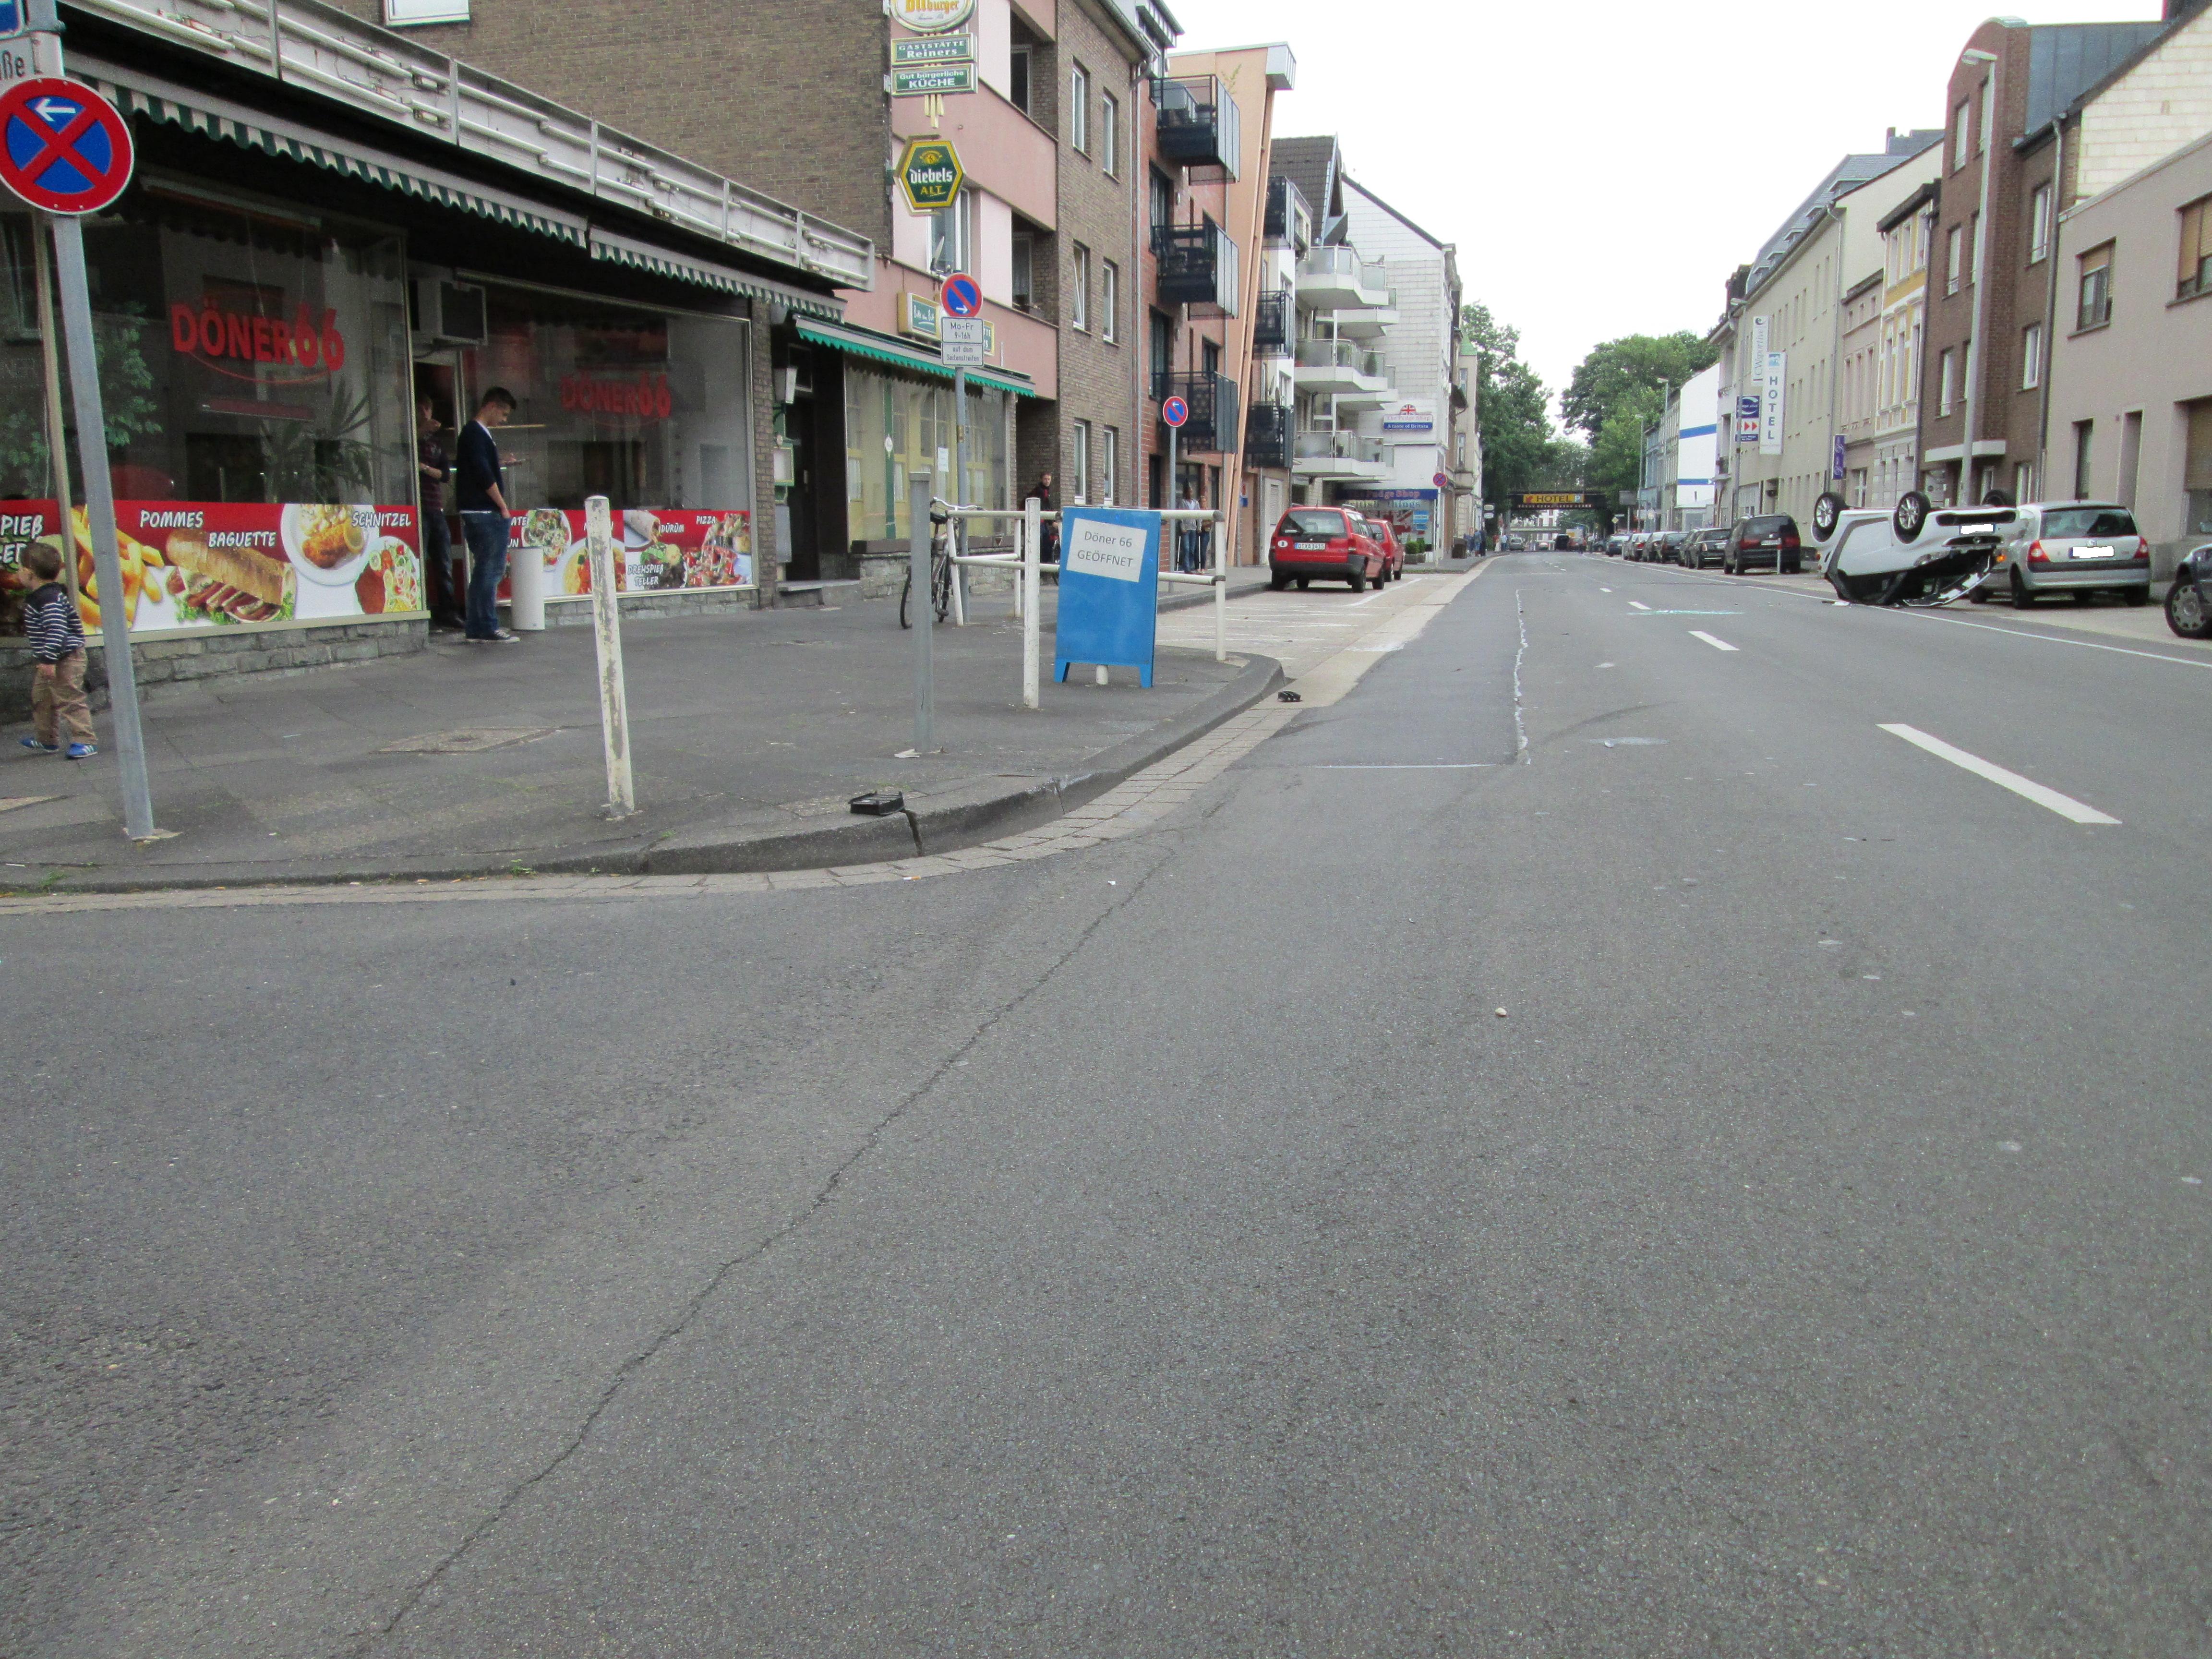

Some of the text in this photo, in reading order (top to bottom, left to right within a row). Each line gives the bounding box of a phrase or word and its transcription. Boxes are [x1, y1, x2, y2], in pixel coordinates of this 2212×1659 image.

[899, 40, 964, 51] GASTSTÄTTE
[907, 49, 957, 58] Reiners
[0, 50, 24, 79] ße
[917, 70, 964, 79] bürgerliche
[909, 78, 955, 89] KÜCHE
[920, 185, 942, 195] ALT
[950, 322, 974, 330] Mo-Fr
[947, 354, 979, 362] Seitenstreifen
[1768, 376, 1778, 439] HOTEL
[140, 509, 204, 528] POMMES
[352, 512, 412, 527] SCHNITZEL
[696, 516, 716, 524] PIZZA
[661, 523, 684, 533] DÜRÜM
[208, 531, 276, 548] BAGUETTE
[1084, 531, 1132, 547] Döner 66
[1078, 550, 1133, 567] GEÖFFNET
[634, 576, 659, 586] TELLER
